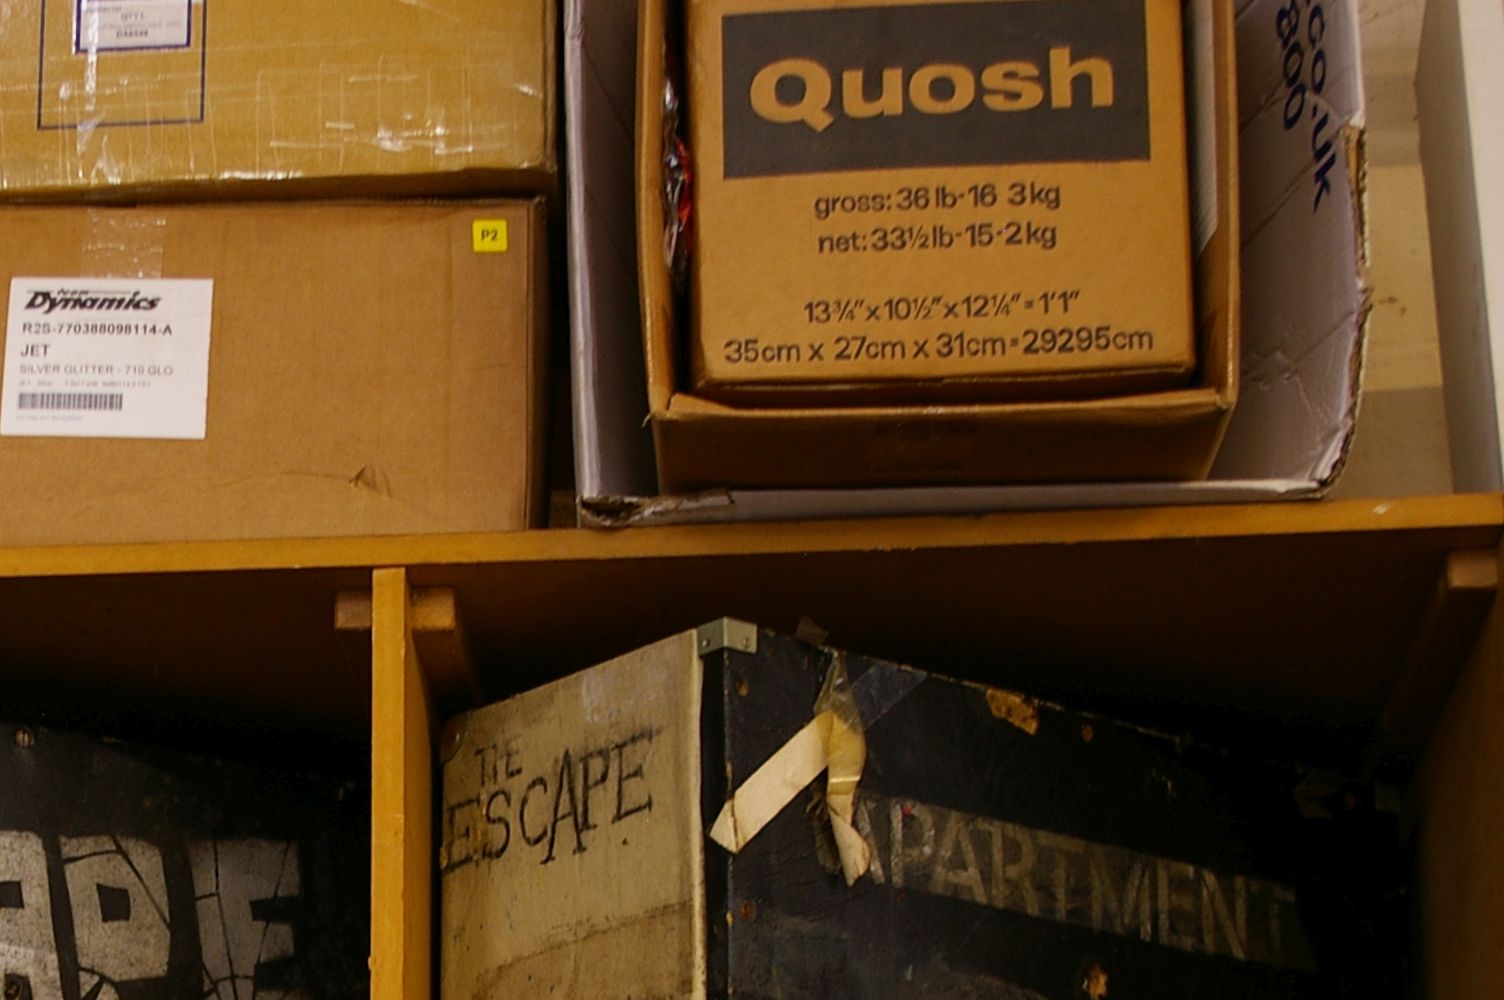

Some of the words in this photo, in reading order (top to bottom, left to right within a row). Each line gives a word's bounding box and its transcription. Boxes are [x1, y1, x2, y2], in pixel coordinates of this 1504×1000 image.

[750, 46, 1114, 133] Quosh
[480, 228, 499, 243] P2
[24, 290, 162, 315] Dynamics
[20, 344, 50, 357] JET
[723, 339, 801, 364] 35cm
[834, 336, 907, 361] 27cm
[19, 365, 60, 376] SILVER
[64, 365, 114, 376] GLITTER
[440, 727, 663, 876] ESCAPE
